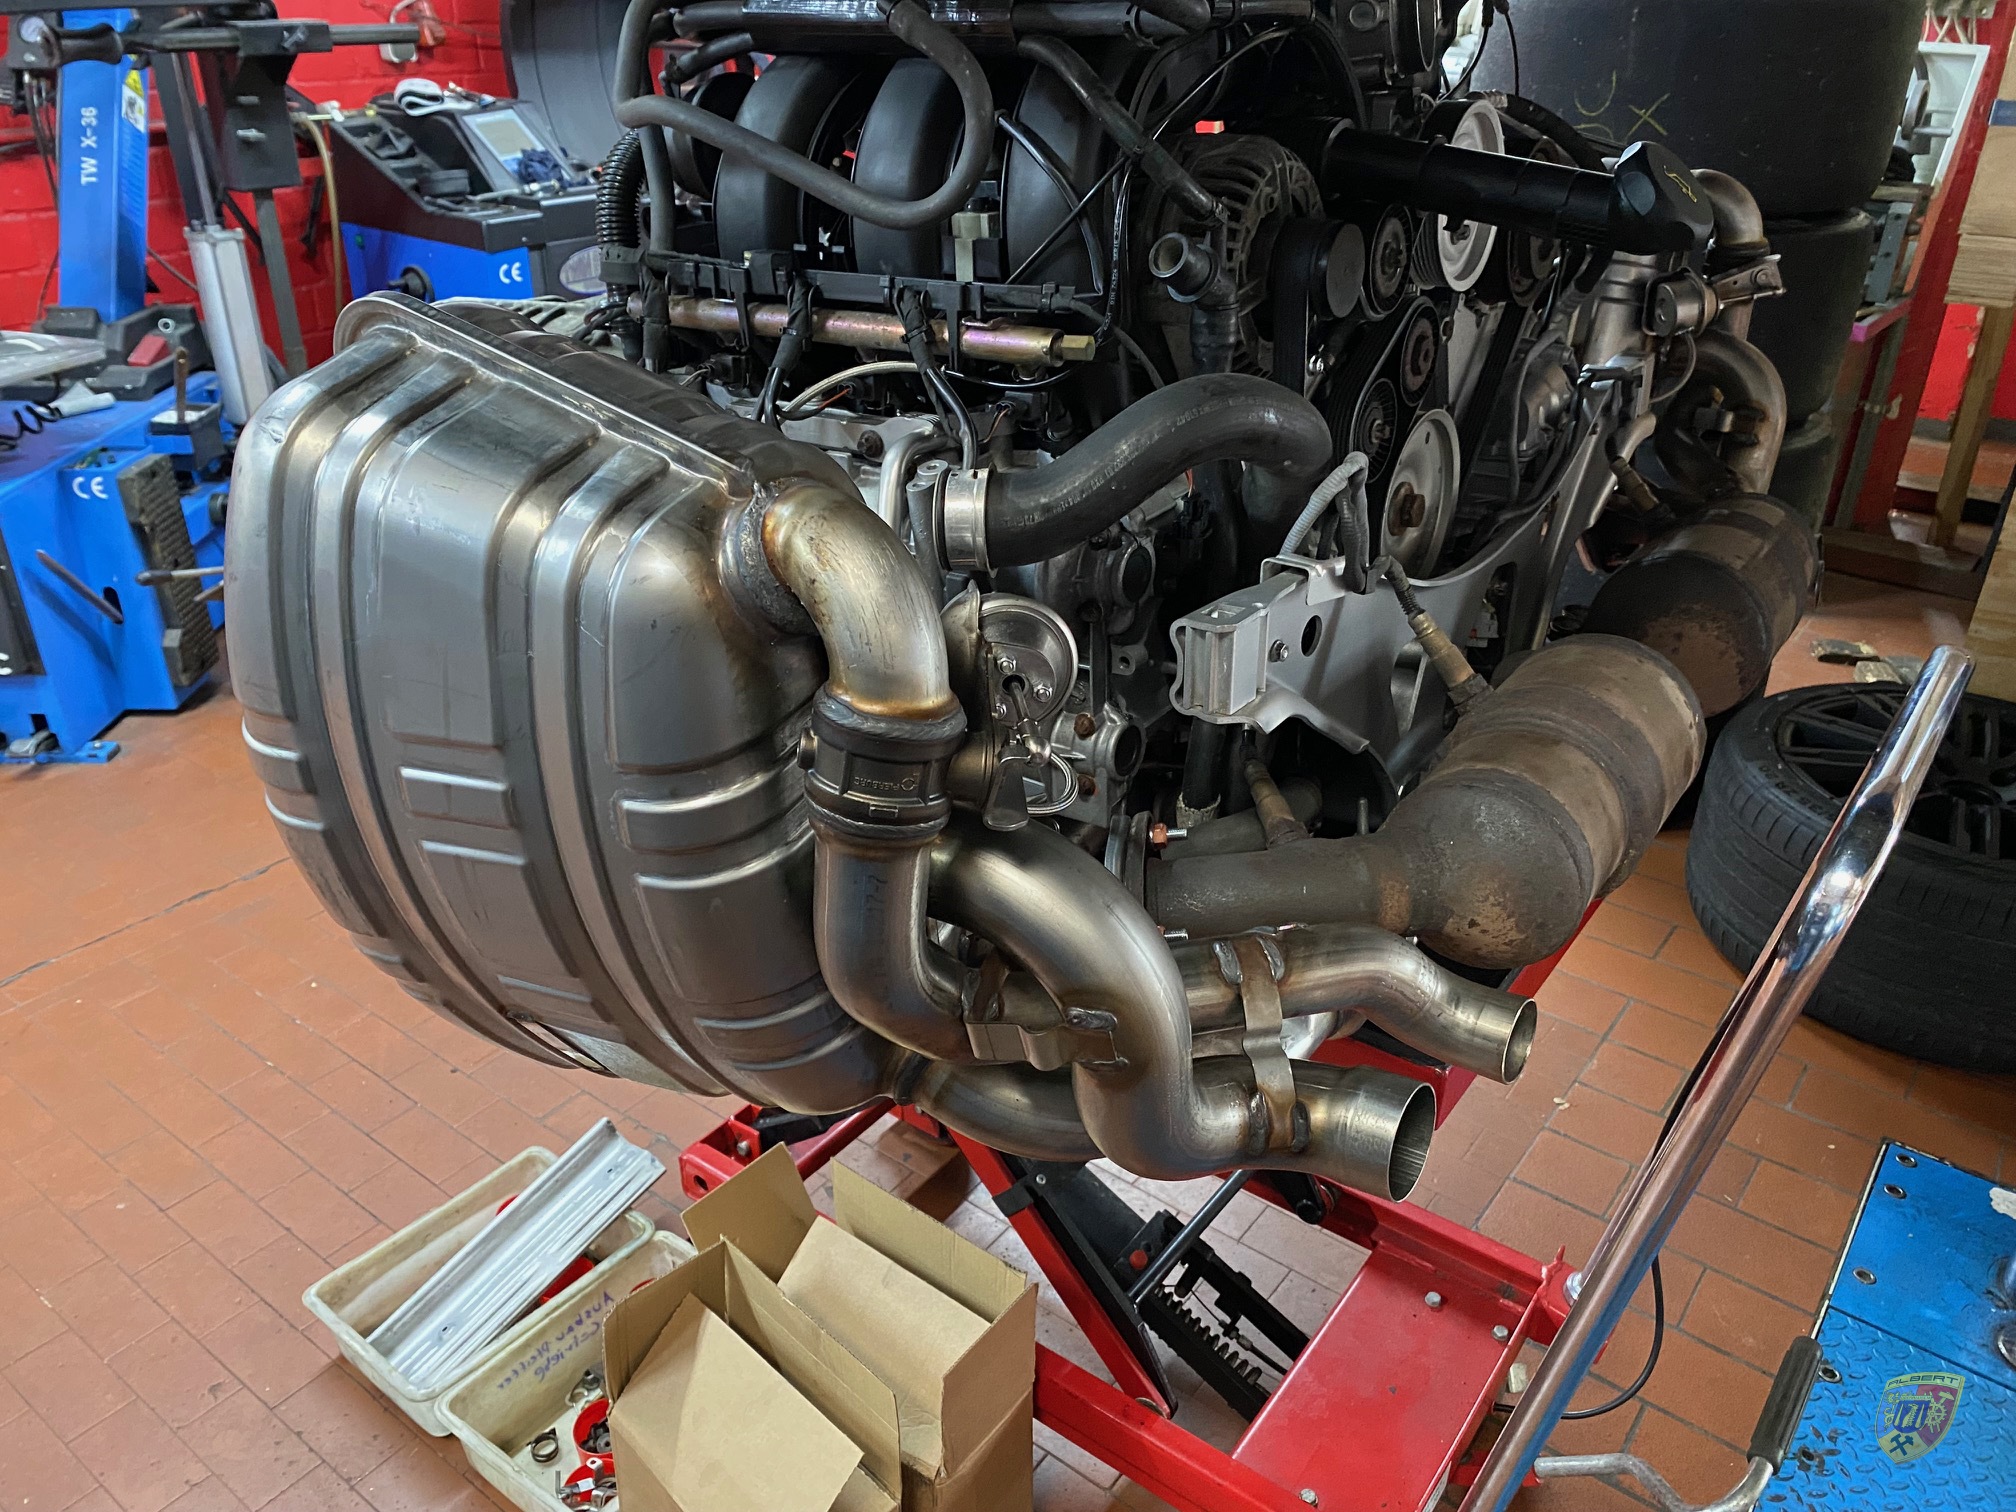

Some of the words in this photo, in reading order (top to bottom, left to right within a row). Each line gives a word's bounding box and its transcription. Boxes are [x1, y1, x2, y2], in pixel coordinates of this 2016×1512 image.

[80, 106, 98, 149] X-36
[80, 156, 98, 186] TW
[499, 261, 524, 285] CE
[72, 476, 109, 500] CE
